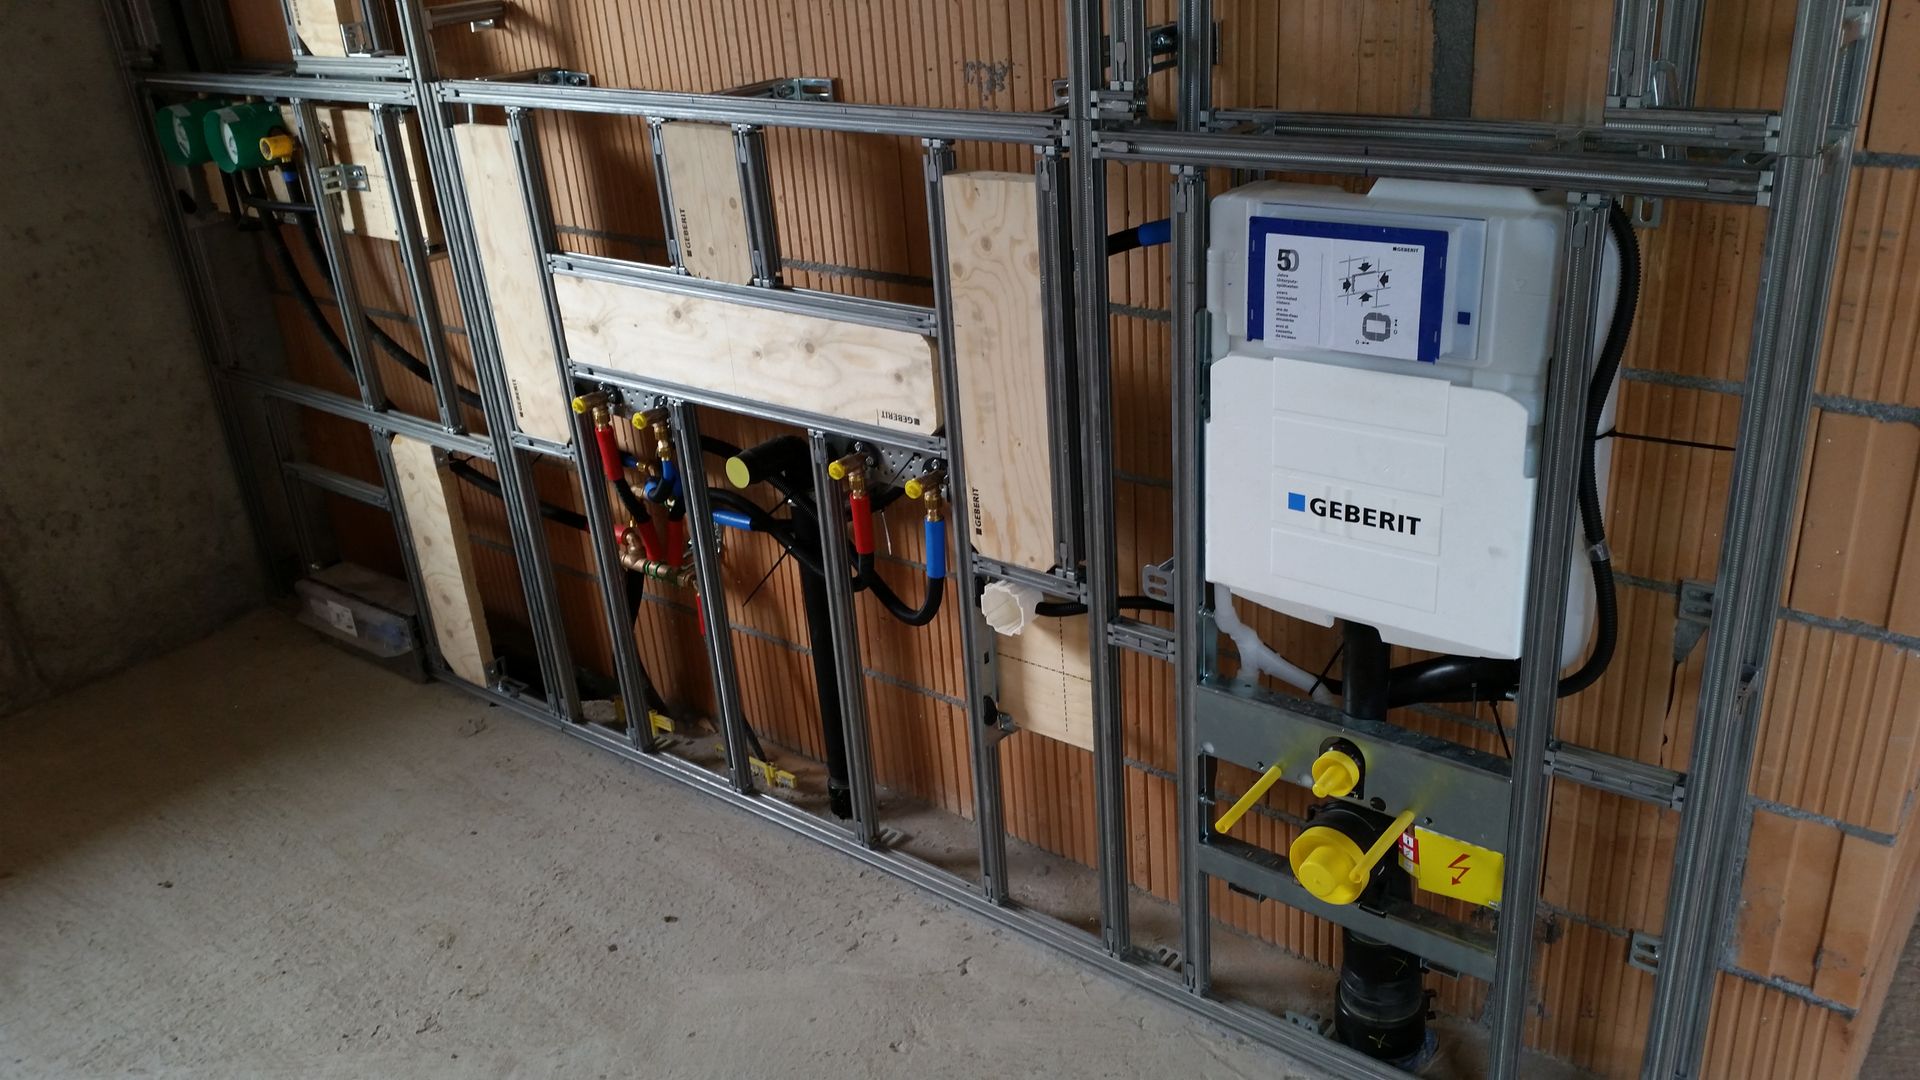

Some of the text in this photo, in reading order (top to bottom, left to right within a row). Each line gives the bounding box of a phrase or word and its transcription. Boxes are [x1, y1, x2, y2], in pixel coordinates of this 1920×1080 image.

[680, 208, 691, 249] GEBERIT
[1277, 249, 1300, 272] 50
[881, 410, 913, 425] GEBERIT
[972, 487, 982, 527] GEBERIT
[1310, 498, 1421, 535] GEBERIT
